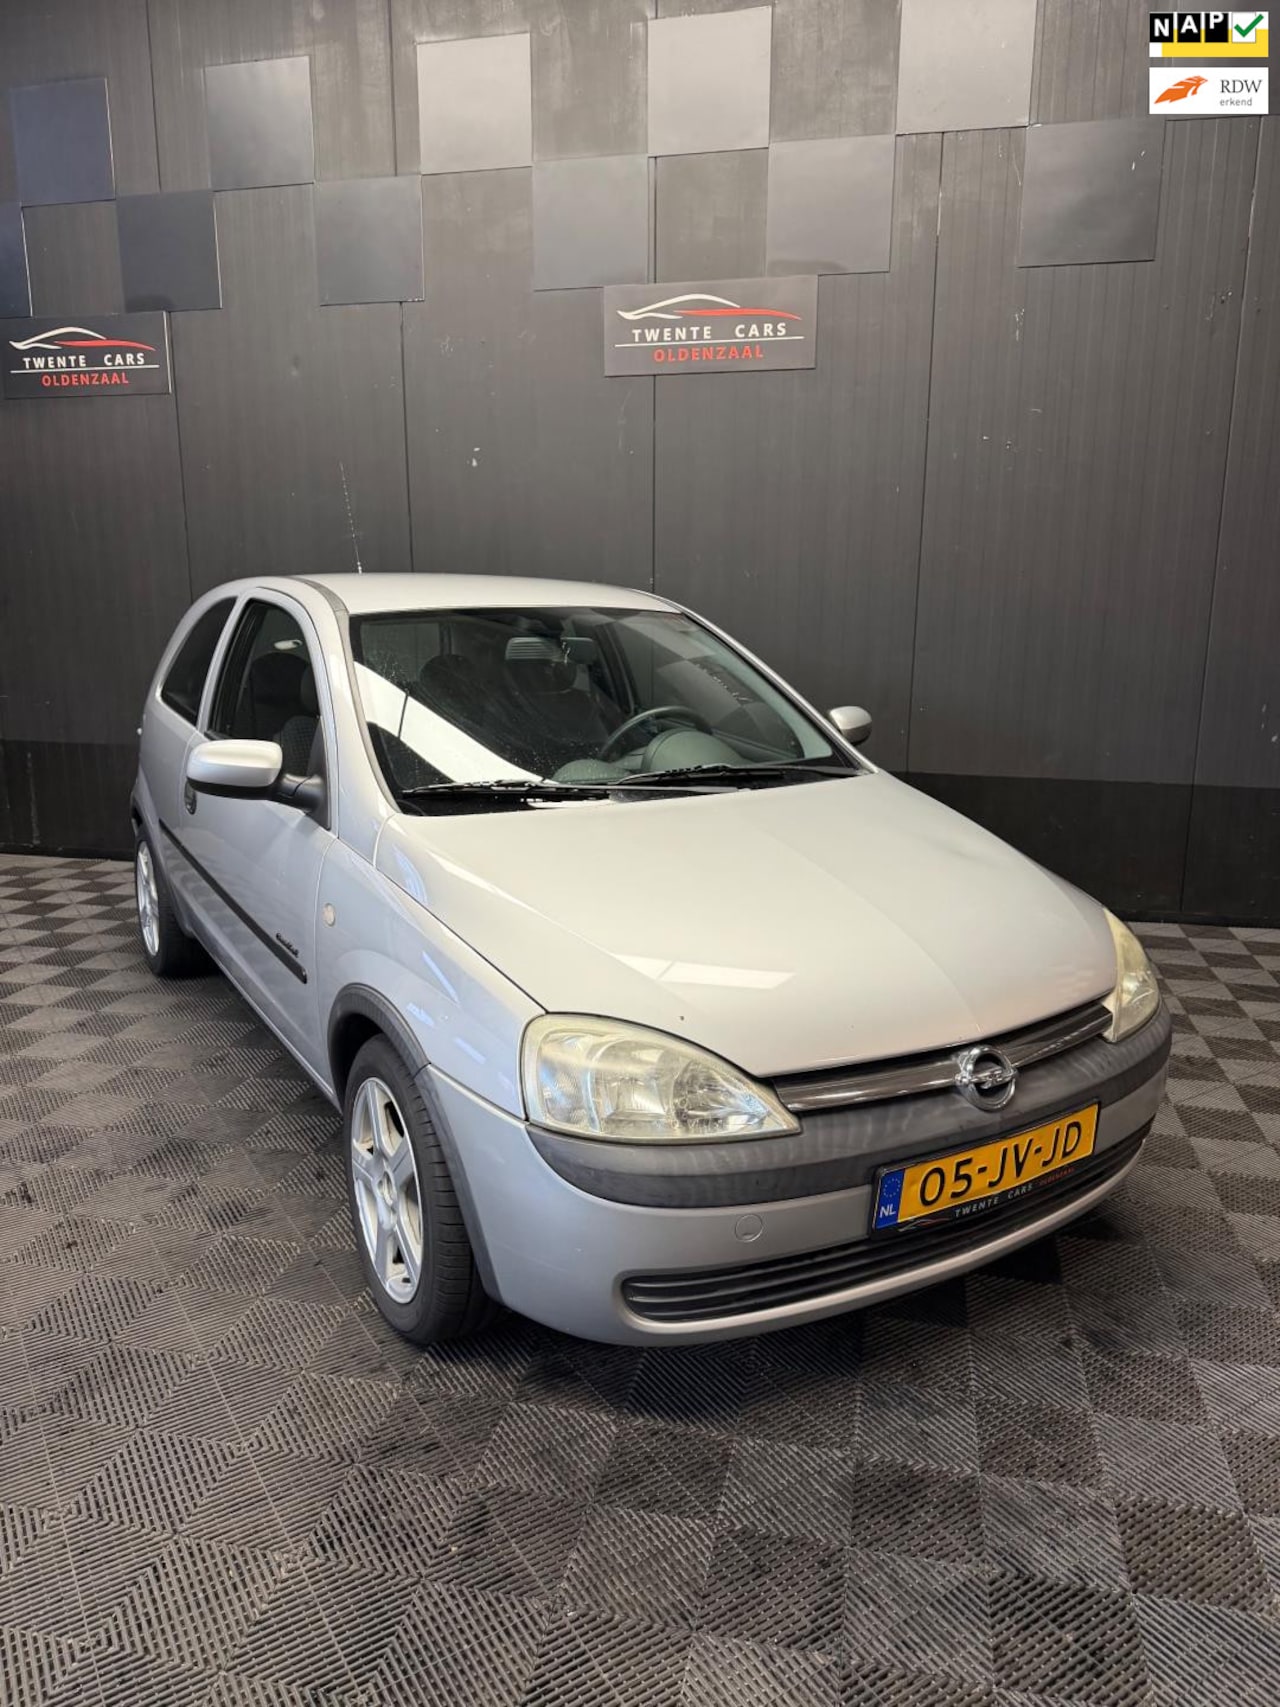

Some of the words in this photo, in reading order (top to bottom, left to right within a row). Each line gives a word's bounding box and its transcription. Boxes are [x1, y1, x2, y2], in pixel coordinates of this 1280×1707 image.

[632, 326, 711, 342] TWENTE
[735, 322, 787, 338] CARS
[23, 355, 87, 369] TWENTE
[104, 352, 145, 366] CARS
[653, 345, 764, 362] OLDENZAAL
[42, 372, 129, 387] OLDENZAAL
[919, 1121, 1083, 1207] 05-JV-JD
[954, 1196, 1000, 1218] TWENTE
[1007, 1183, 1034, 1200] CARS
[879, 1203, 896, 1219] NL
